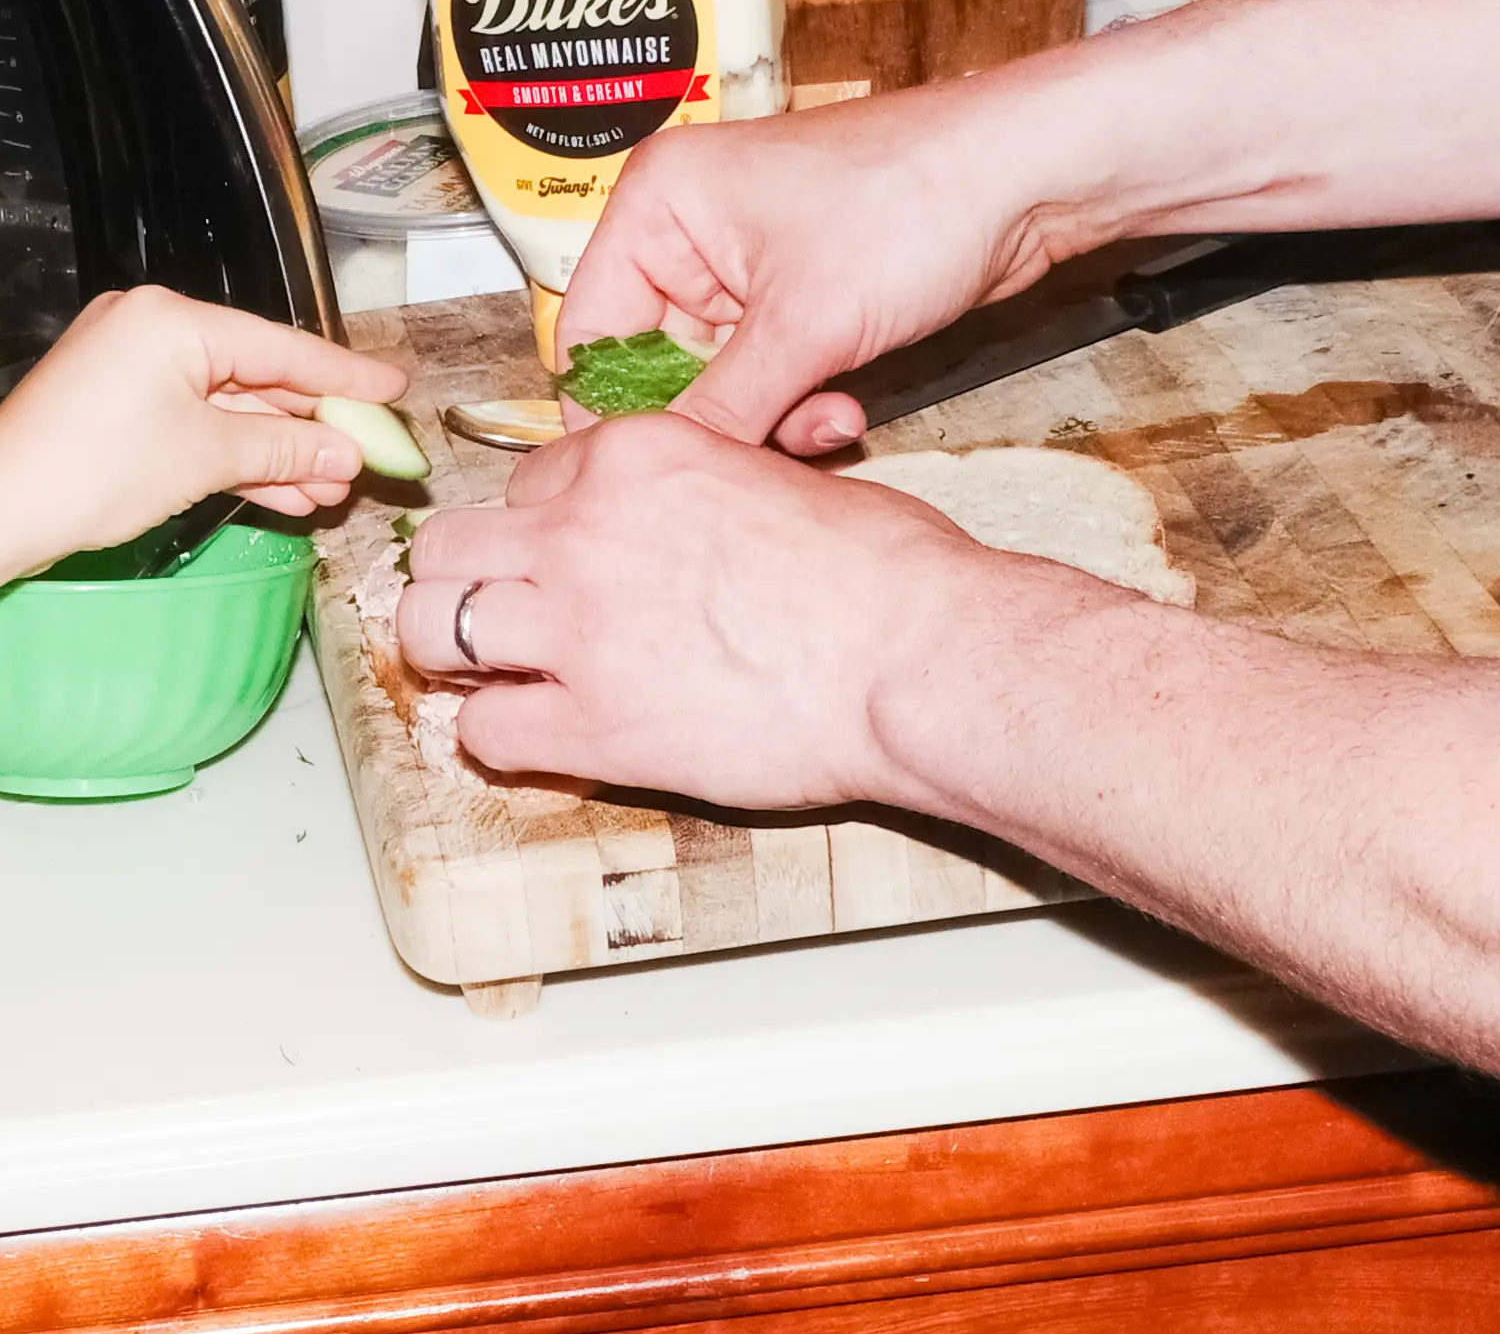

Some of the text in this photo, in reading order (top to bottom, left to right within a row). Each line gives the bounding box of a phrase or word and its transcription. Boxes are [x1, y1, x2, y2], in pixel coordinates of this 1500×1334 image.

[479, 35, 671, 74] REAL MAYONNAISE
[512, 79, 644, 105] SMOOTH & CREAMY
[525, 122, 545, 139] NET
[516, 178, 533, 192] GIVE
[538, 174, 597, 198] Twang!
